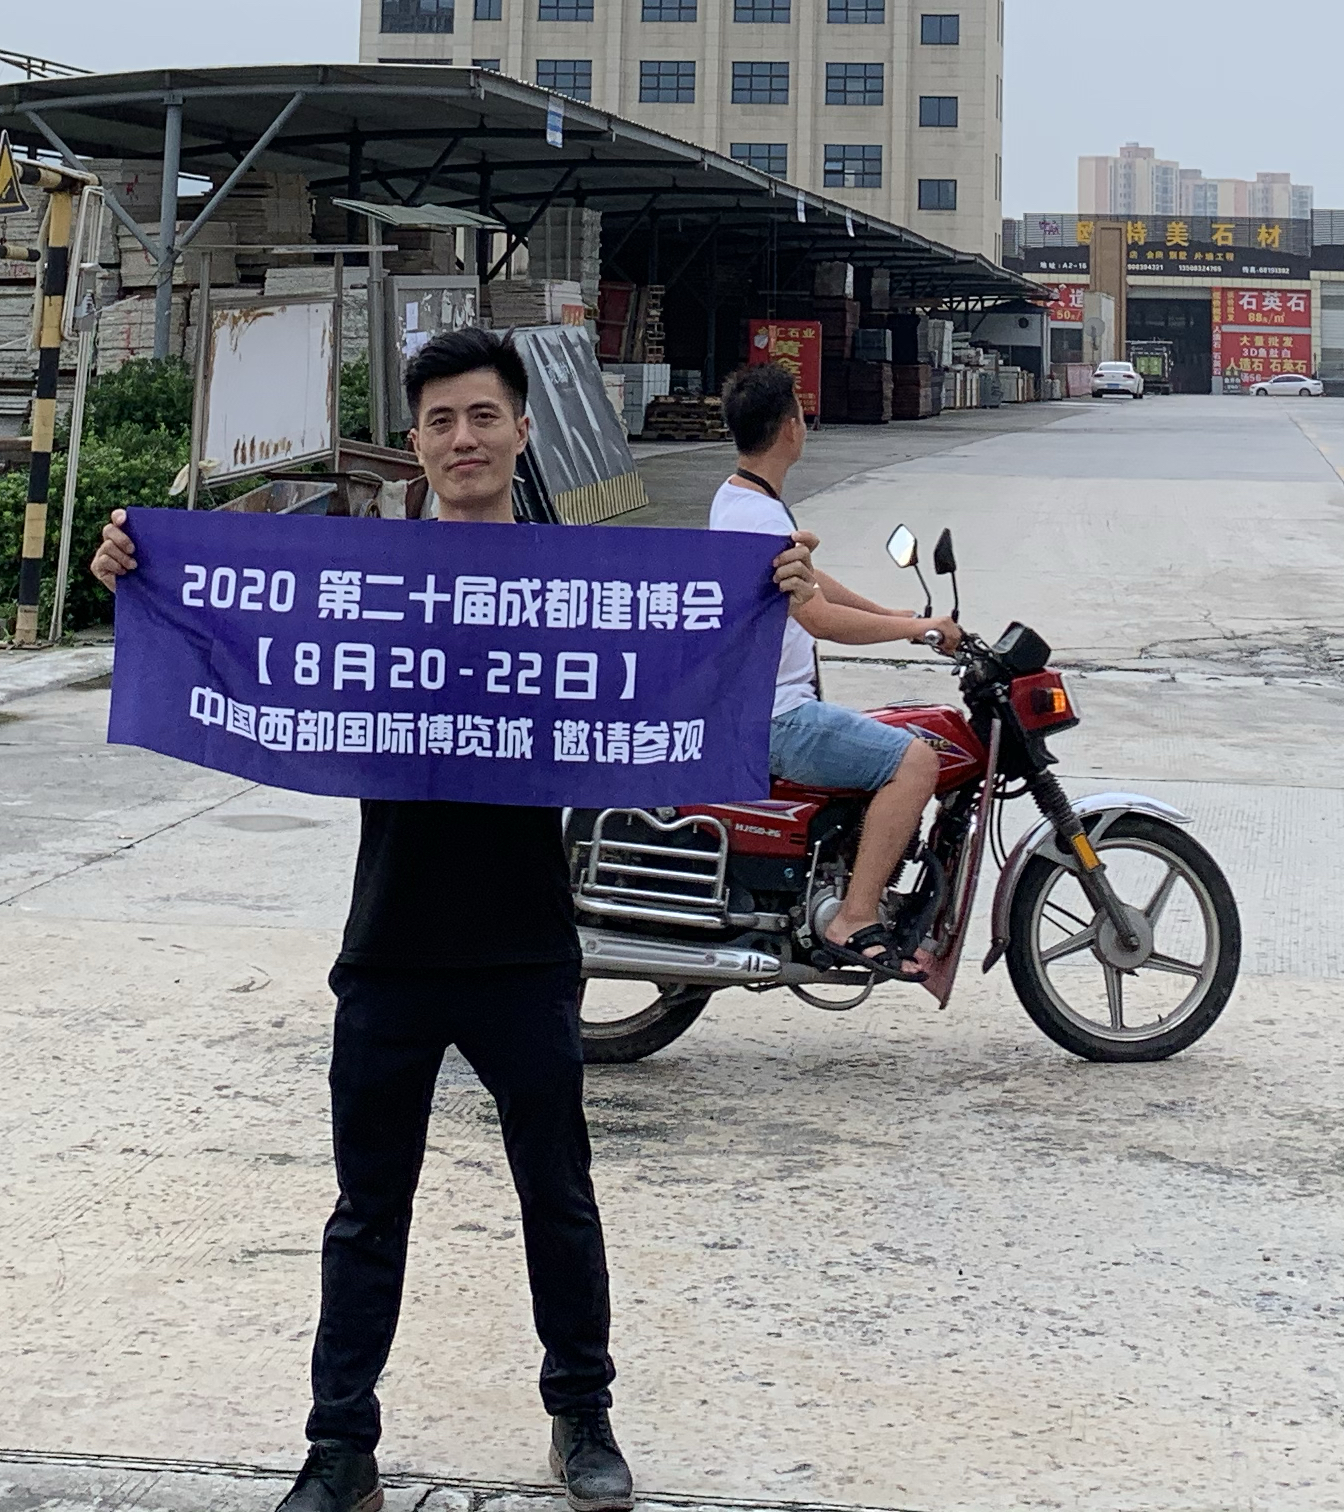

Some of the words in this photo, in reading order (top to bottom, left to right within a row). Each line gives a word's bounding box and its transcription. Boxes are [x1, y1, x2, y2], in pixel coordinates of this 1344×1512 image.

[1238, 291, 1308, 312] 石英石
[182, 564, 297, 613] 2020
[317, 569, 725, 632] 第二十届成都建博会
[189, 685, 534, 761] 中国西部国际博览城
[553, 718, 705, 766] 邀请参观
